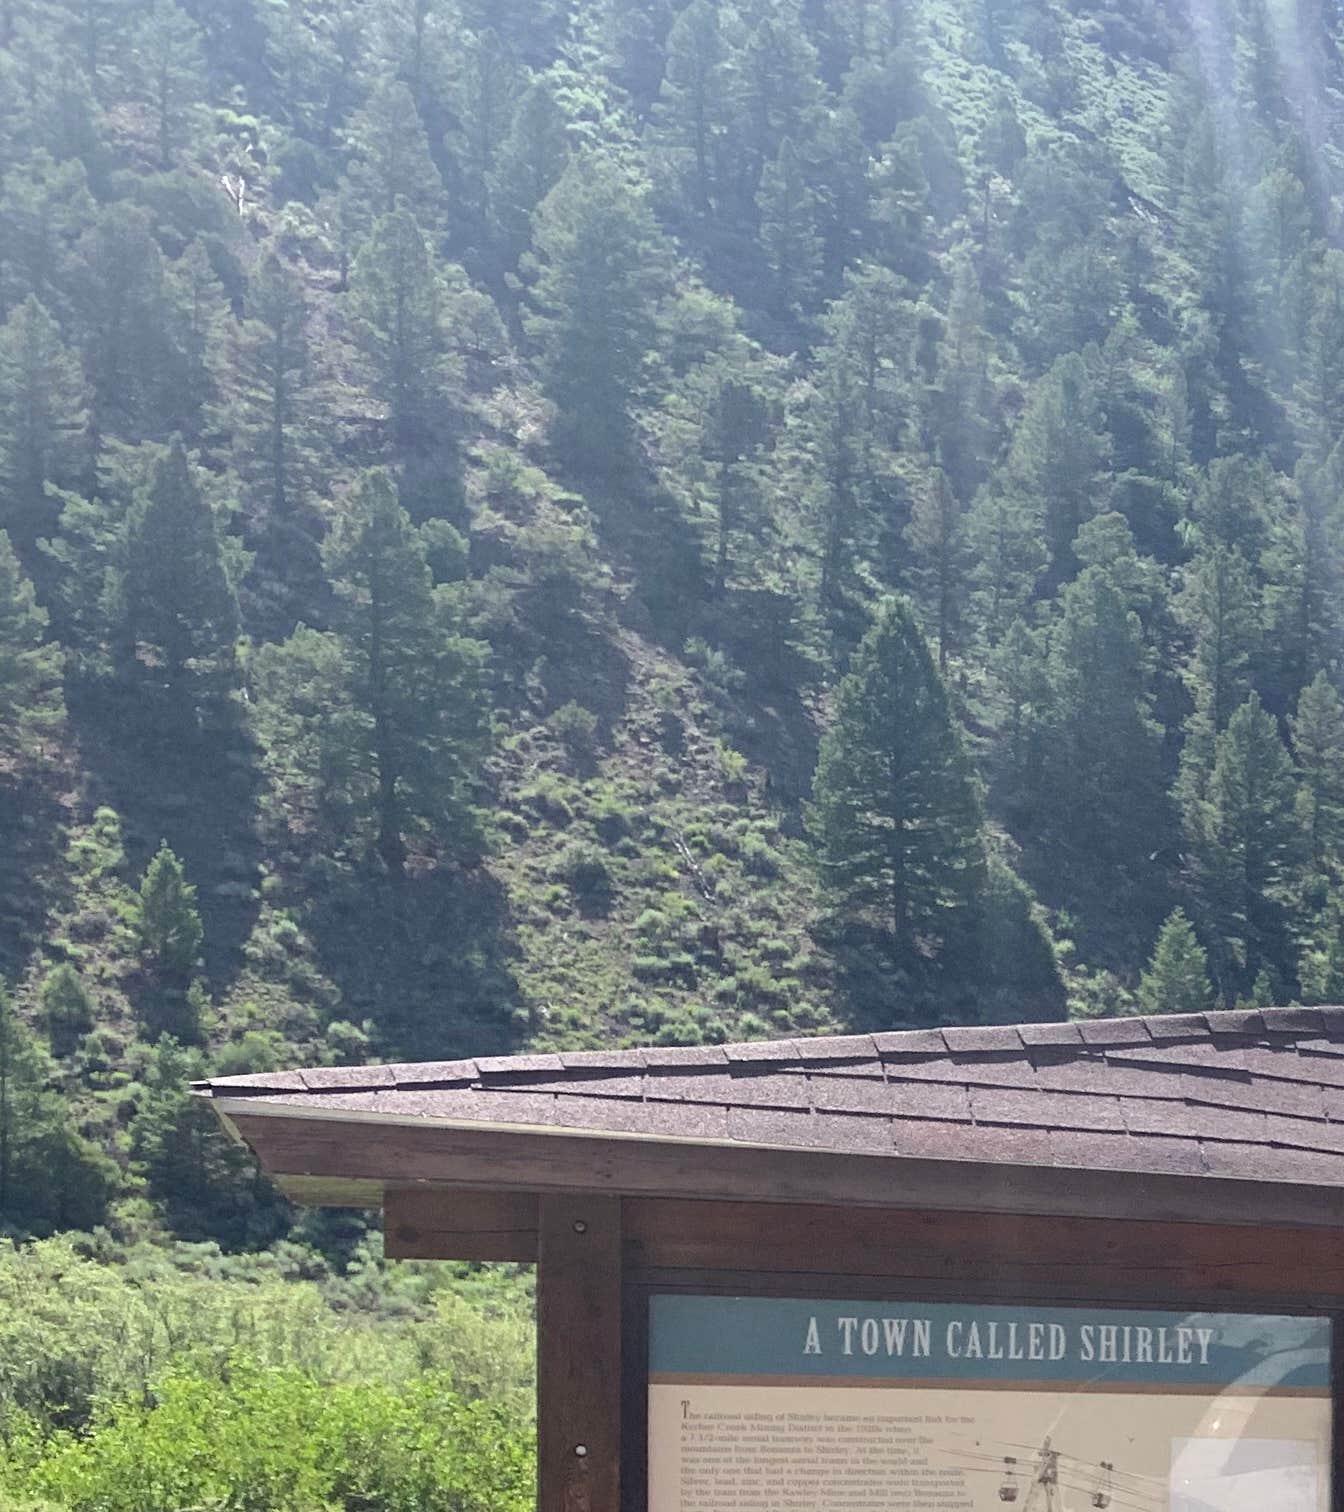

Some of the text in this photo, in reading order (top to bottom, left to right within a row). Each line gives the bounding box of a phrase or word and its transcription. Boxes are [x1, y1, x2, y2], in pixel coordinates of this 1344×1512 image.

[803, 1317, 1215, 1365] A TOWN CALLED SHIRLEY
